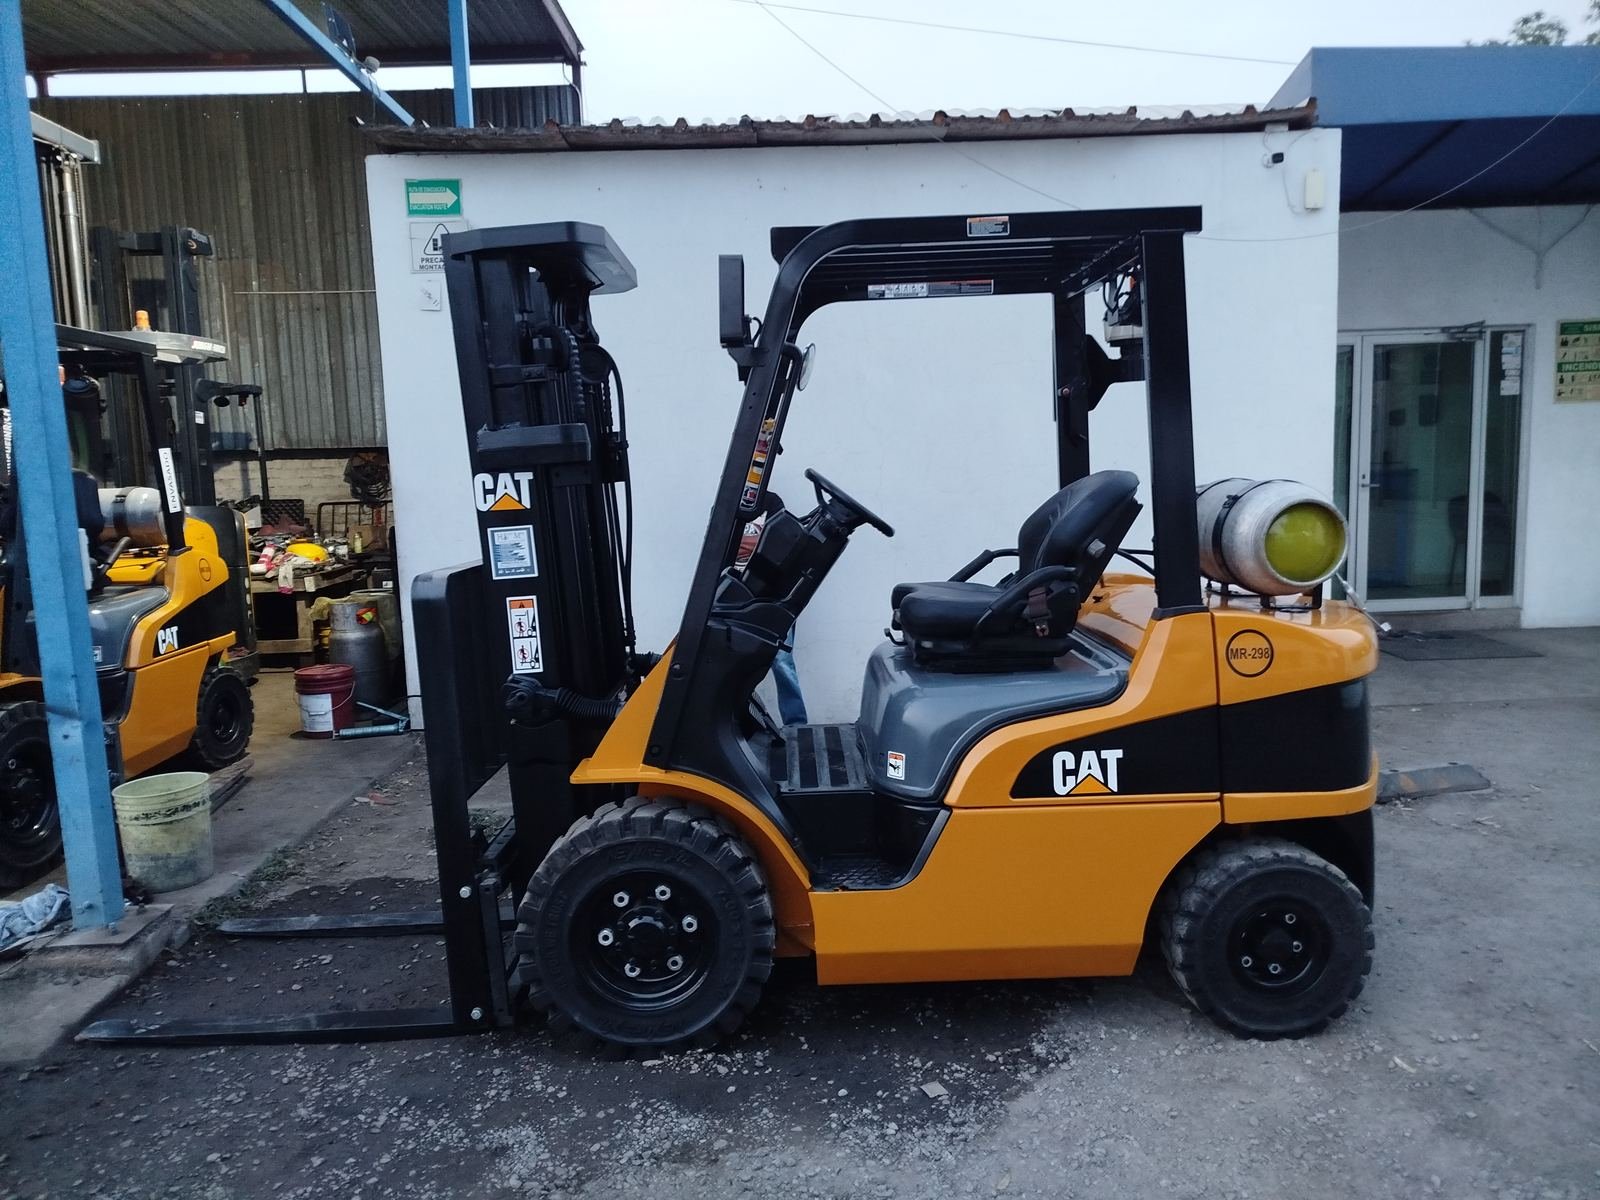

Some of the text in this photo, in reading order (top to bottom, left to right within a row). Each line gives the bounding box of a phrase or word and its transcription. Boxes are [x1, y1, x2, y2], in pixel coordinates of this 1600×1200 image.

[474, 472, 533, 512] CAT
[157, 626, 178, 655] CAT
[1229, 647, 1270, 660] MR-298
[1052, 749, 1123, 796] CAT
